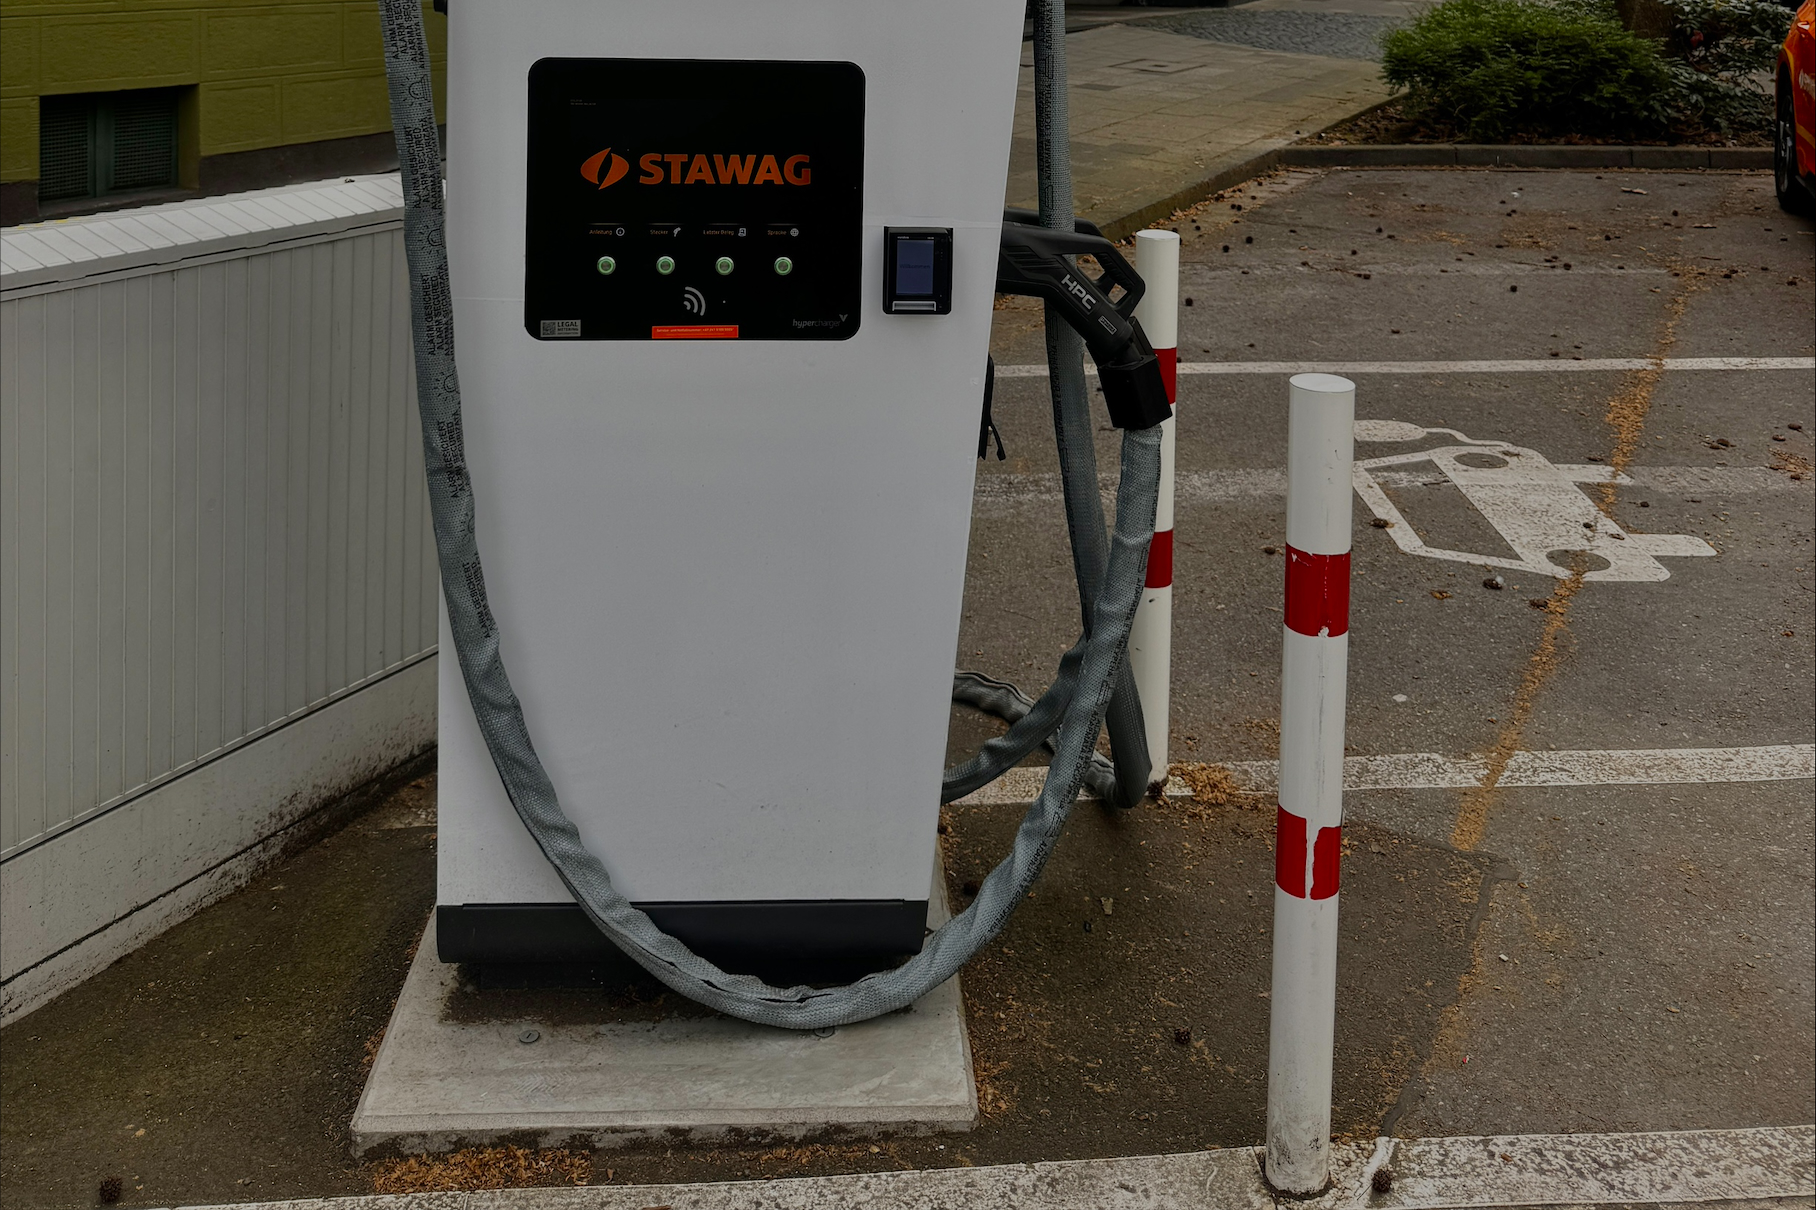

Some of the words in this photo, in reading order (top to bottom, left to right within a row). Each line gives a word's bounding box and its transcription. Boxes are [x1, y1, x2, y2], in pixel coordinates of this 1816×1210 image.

[639, 153, 812, 186] STAWAG
[1060, 273, 1098, 311] HPC
[792, 318, 841, 329] hypercharger
